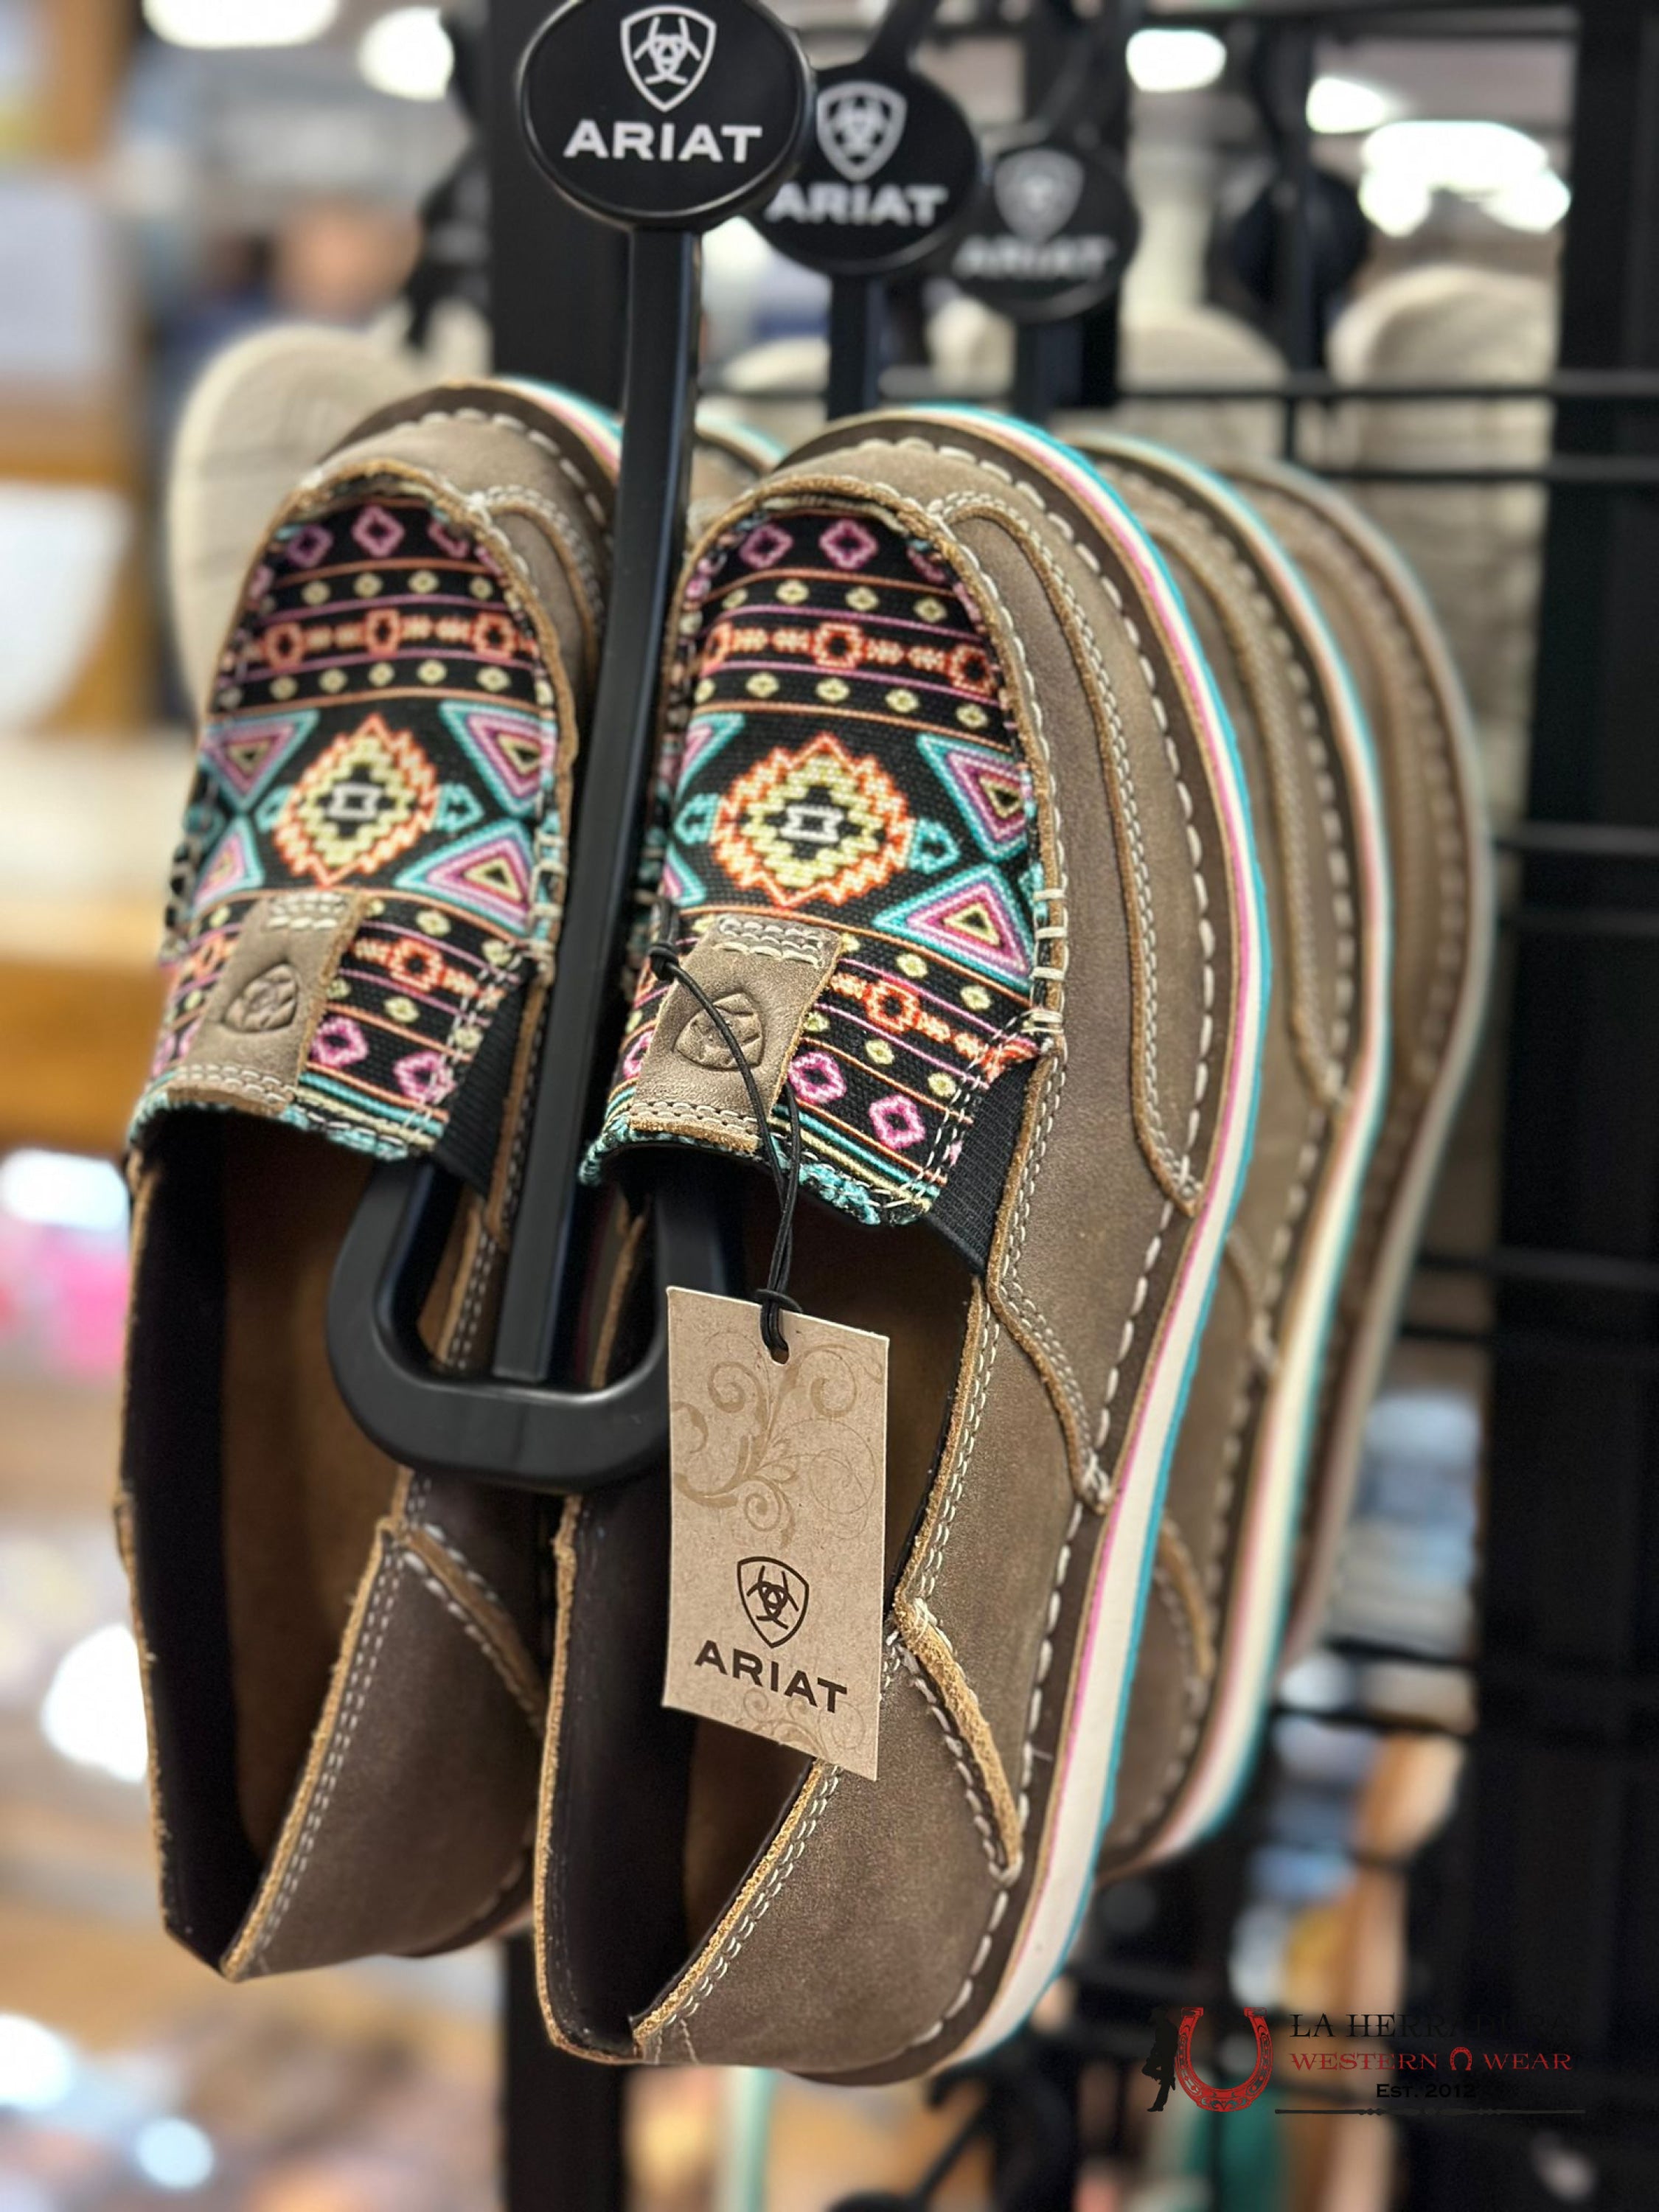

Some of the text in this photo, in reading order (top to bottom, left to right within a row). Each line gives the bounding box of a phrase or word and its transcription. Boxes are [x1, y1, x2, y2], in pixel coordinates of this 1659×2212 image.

[563, 118, 762, 163] ARIAT
[764, 182, 950, 226] ARIAT
[695, 1640, 847, 1714] ARIAT
